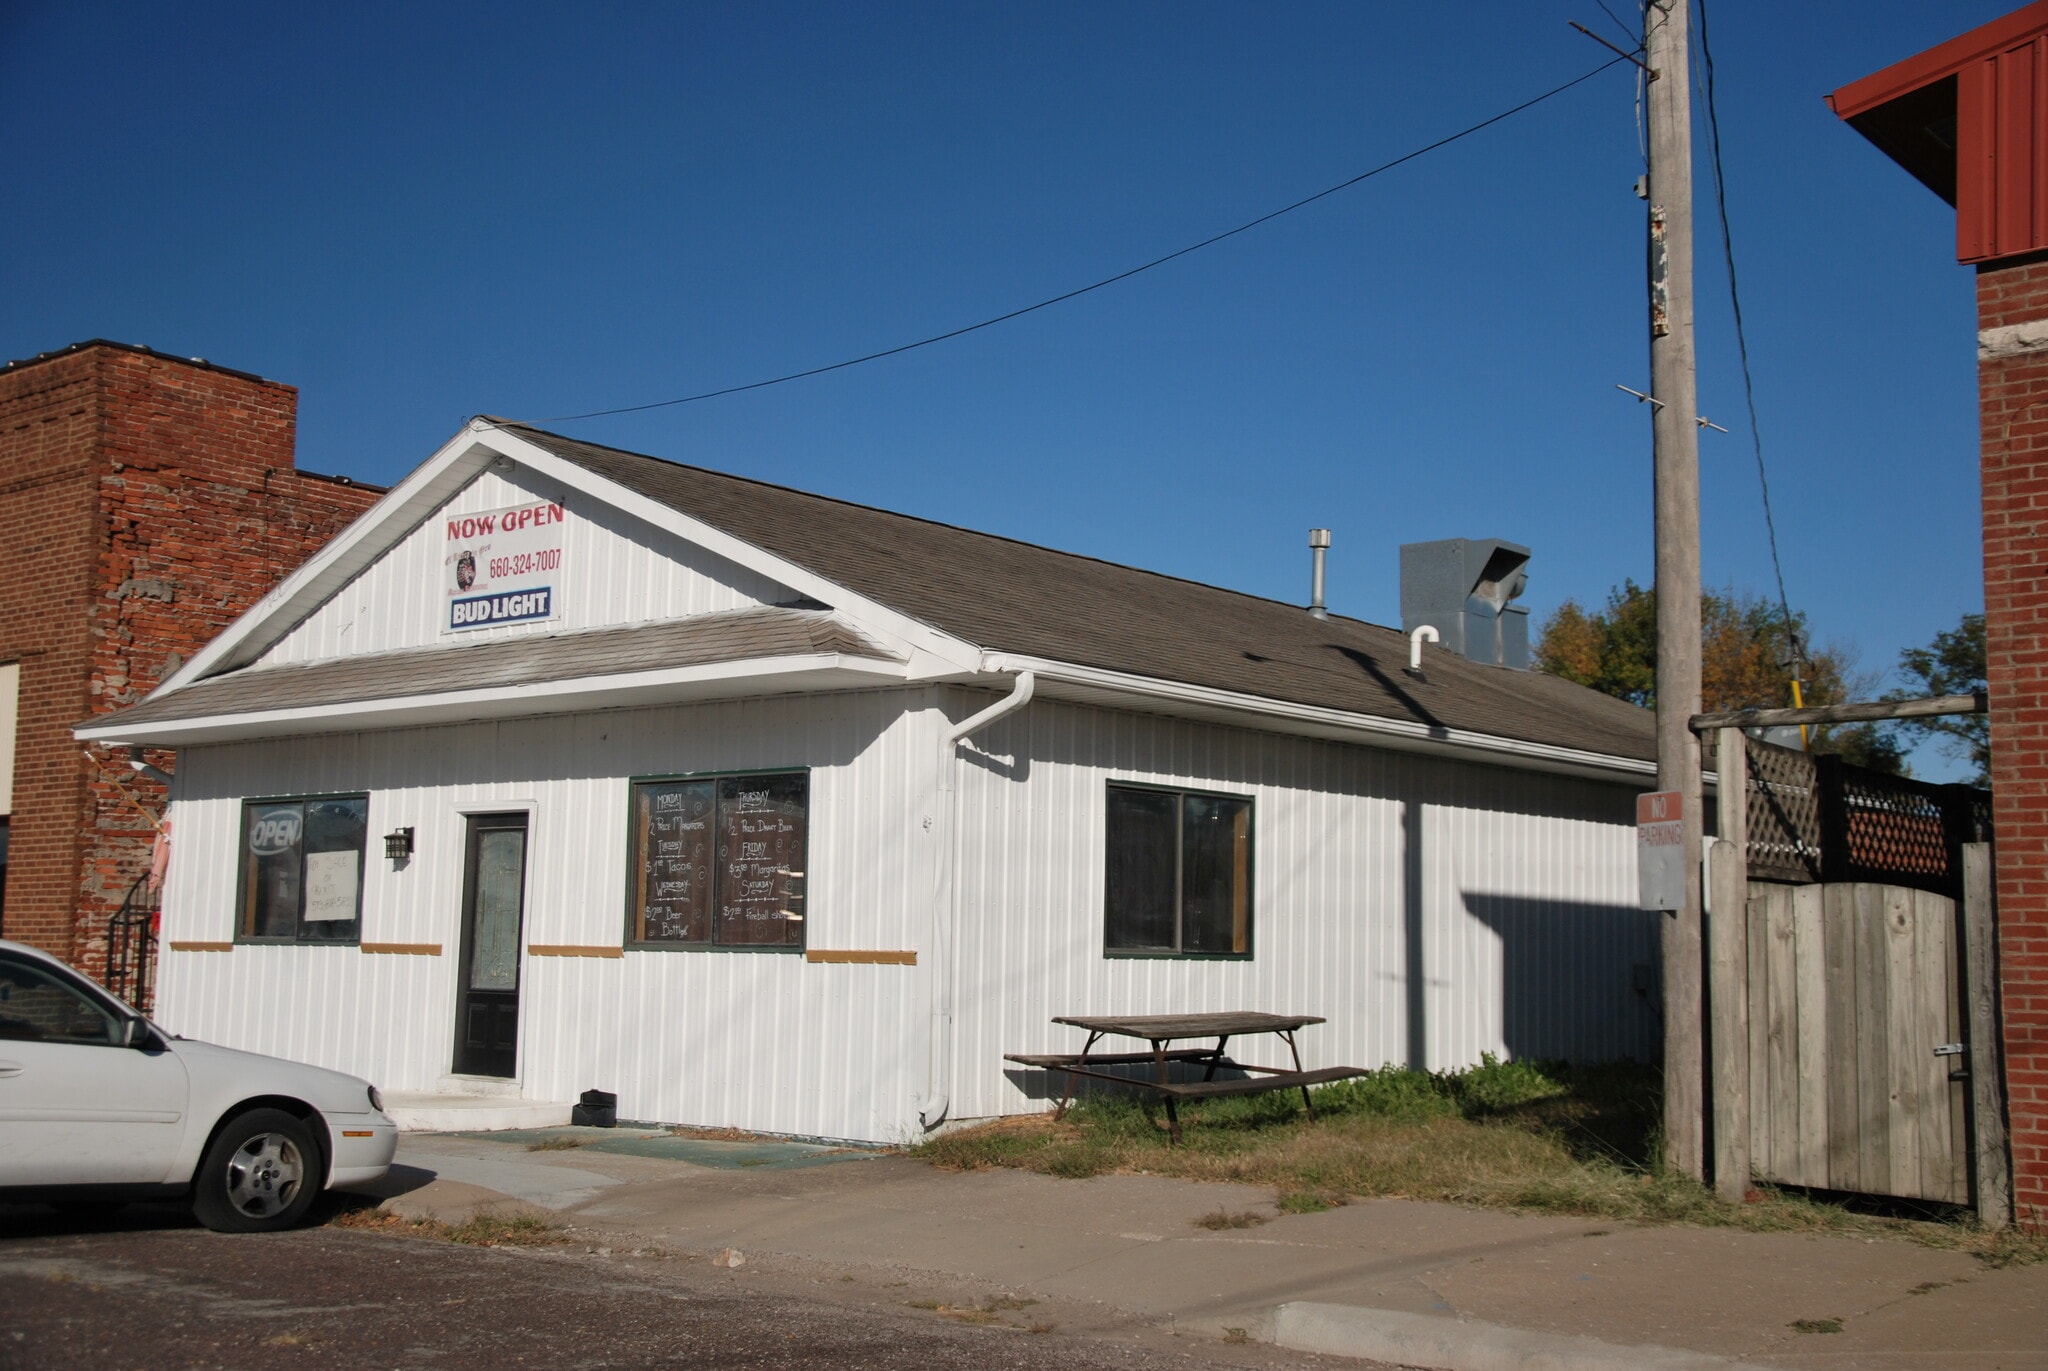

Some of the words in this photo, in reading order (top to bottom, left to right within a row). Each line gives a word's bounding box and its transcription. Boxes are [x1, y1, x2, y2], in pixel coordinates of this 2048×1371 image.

[447, 515, 497, 541] NOW
[501, 503, 565, 532] OPEN
[490, 548, 561, 579] 660-324-7007
[452, 600, 491, 624] BUD
[492, 592, 549, 619] LIGHT
[657, 793, 683, 810] MONDAY
[738, 789, 770, 810] THURSDAY
[1651, 797, 1668, 819] NO
[253, 820, 299, 847] OPEN
[1638, 824, 1684, 847] PARKING
[657, 840, 683, 855] TUESDAY
[742, 842, 767, 858] FRIDAY
[751, 862, 791, 878] Margaritas
[740, 879, 775, 897] SATURDAY
